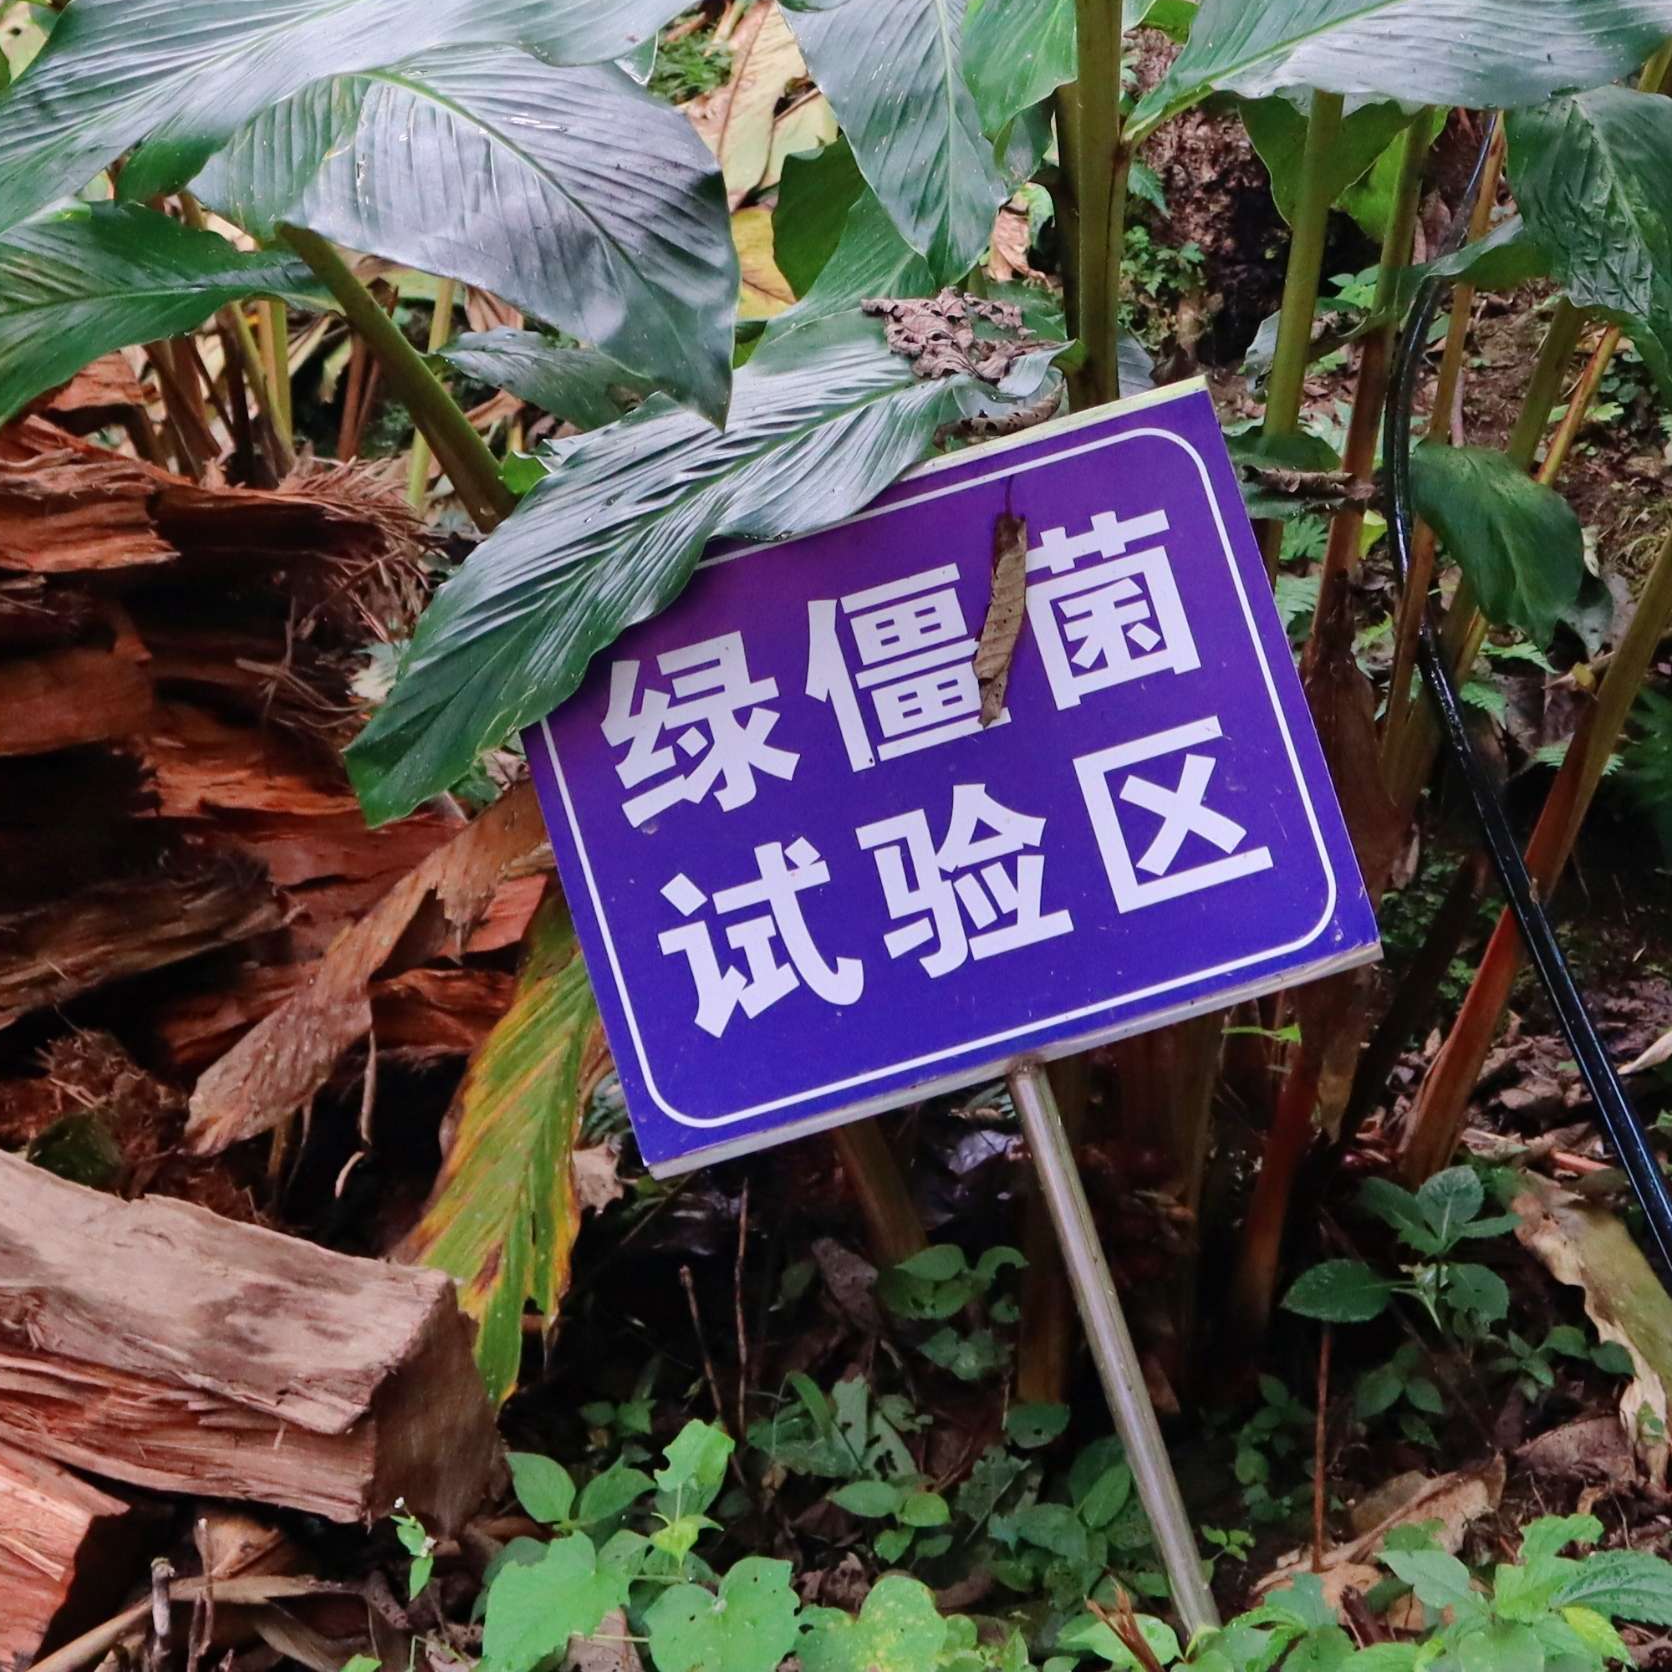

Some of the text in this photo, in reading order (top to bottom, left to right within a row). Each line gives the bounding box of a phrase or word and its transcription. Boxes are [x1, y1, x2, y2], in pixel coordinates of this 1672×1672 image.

[600, 509, 1202, 829] 绿僵菌
[658, 715, 1274, 1039] 试验区
